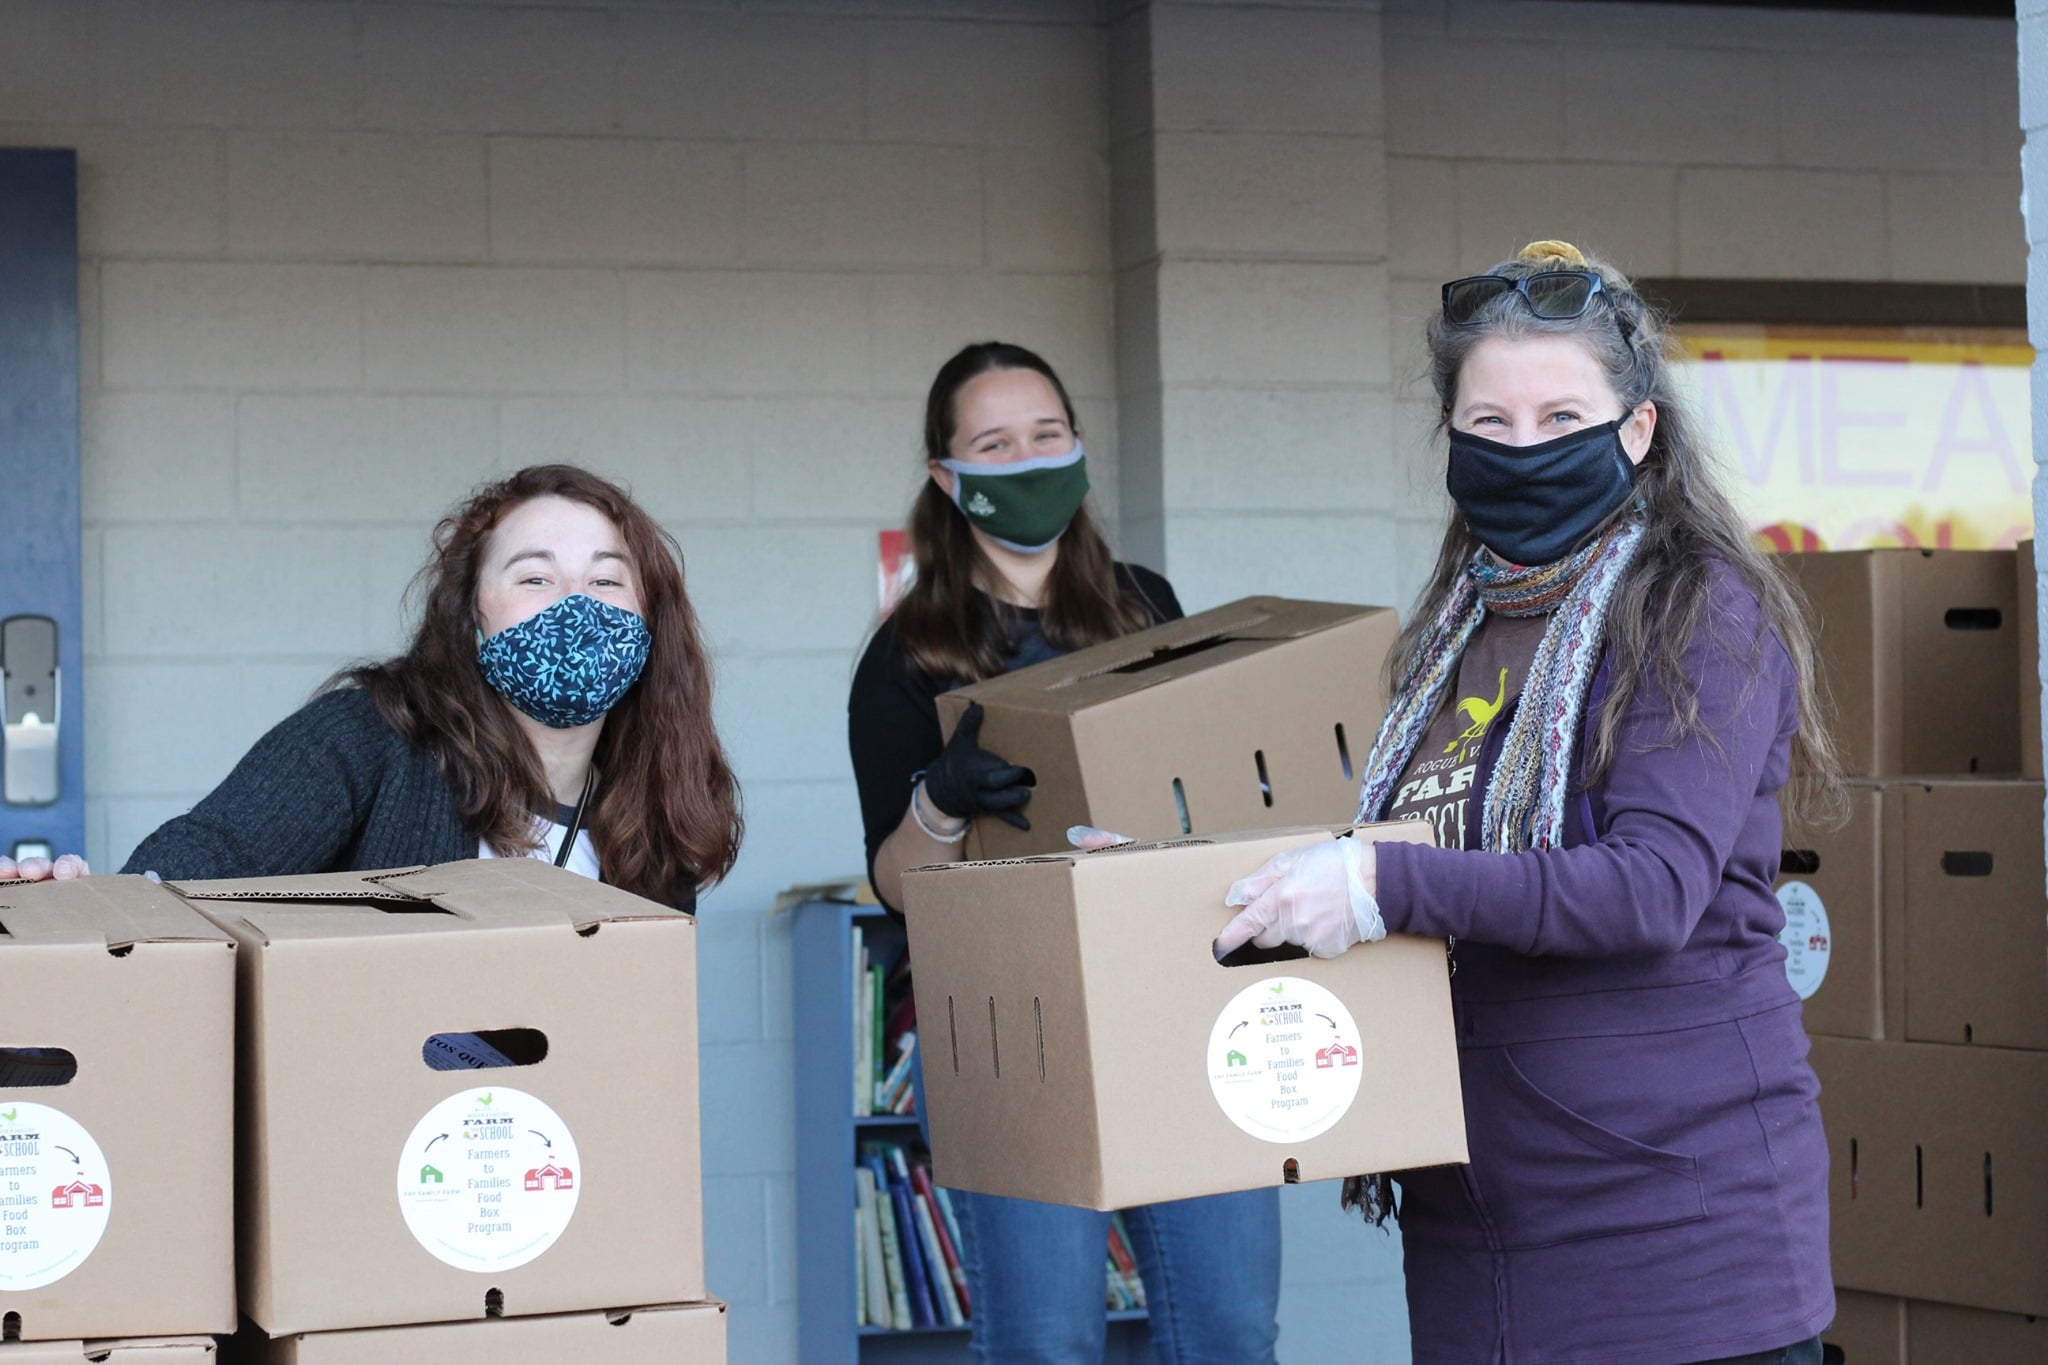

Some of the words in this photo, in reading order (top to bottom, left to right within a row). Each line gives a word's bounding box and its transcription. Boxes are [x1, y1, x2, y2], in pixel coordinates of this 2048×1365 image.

[1413, 754, 1459, 775] ROGUE
[1469, 745, 1482, 758] V
[1259, 1004, 1303, 1013] FARM
[1274, 1011, 1304, 1025] SCHOOL
[1265, 1032, 1302, 1043] Farmers
[1280, 1046, 1290, 1055] to
[1267, 1057, 1305, 1070] Families
[1277, 1071, 1298, 1081] Food
[1280, 1085, 1297, 1095] Box
[1271, 1097, 1309, 1110] Program
[463, 1117, 514, 1126] FARM
[0, 1133, 40, 1141] ARM
[480, 1126, 514, 1141] SCHOOL
[4, 1141, 40, 1157] SCHOOL
[468, 1149, 510, 1160] Farmers
[0, 1166, 37, 1177] armers
[484, 1163, 494, 1173] to
[9, 1181, 20, 1191] to
[468, 1177, 511, 1189] Families
[0, 1194, 38, 1206] amilies
[477, 1192, 502, 1203] Food
[3, 1209, 28, 1221] Food
[480, 1207, 499, 1218] Box
[6, 1225, 26, 1236] Box
[468, 1221, 512, 1235] Program
[0, 1240, 39, 1254] rogram
